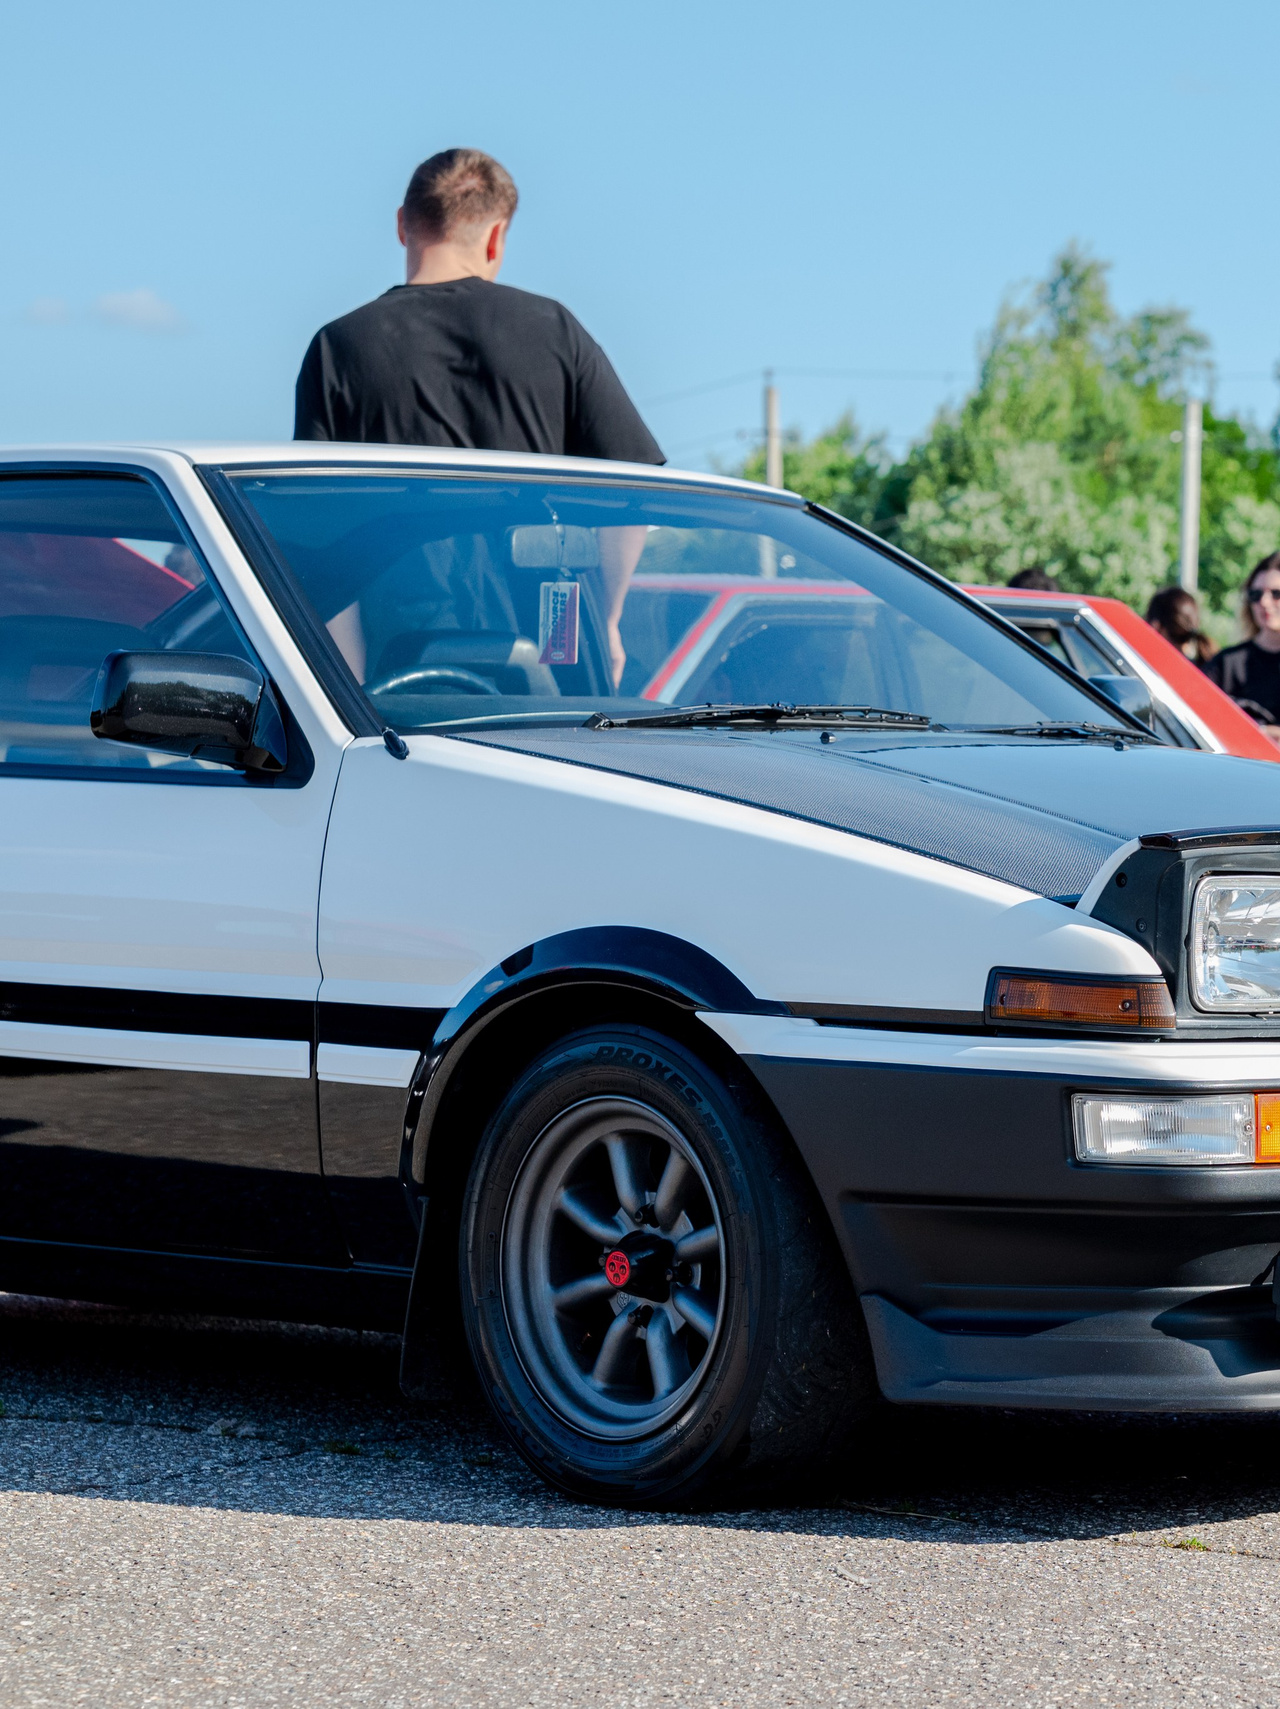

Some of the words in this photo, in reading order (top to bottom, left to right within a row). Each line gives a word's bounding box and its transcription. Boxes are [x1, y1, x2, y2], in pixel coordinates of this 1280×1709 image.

[551, 590, 560, 649] RESOURCE
[560, 591, 568, 649] STICKERS
[593, 1044, 704, 1109] PROXES
